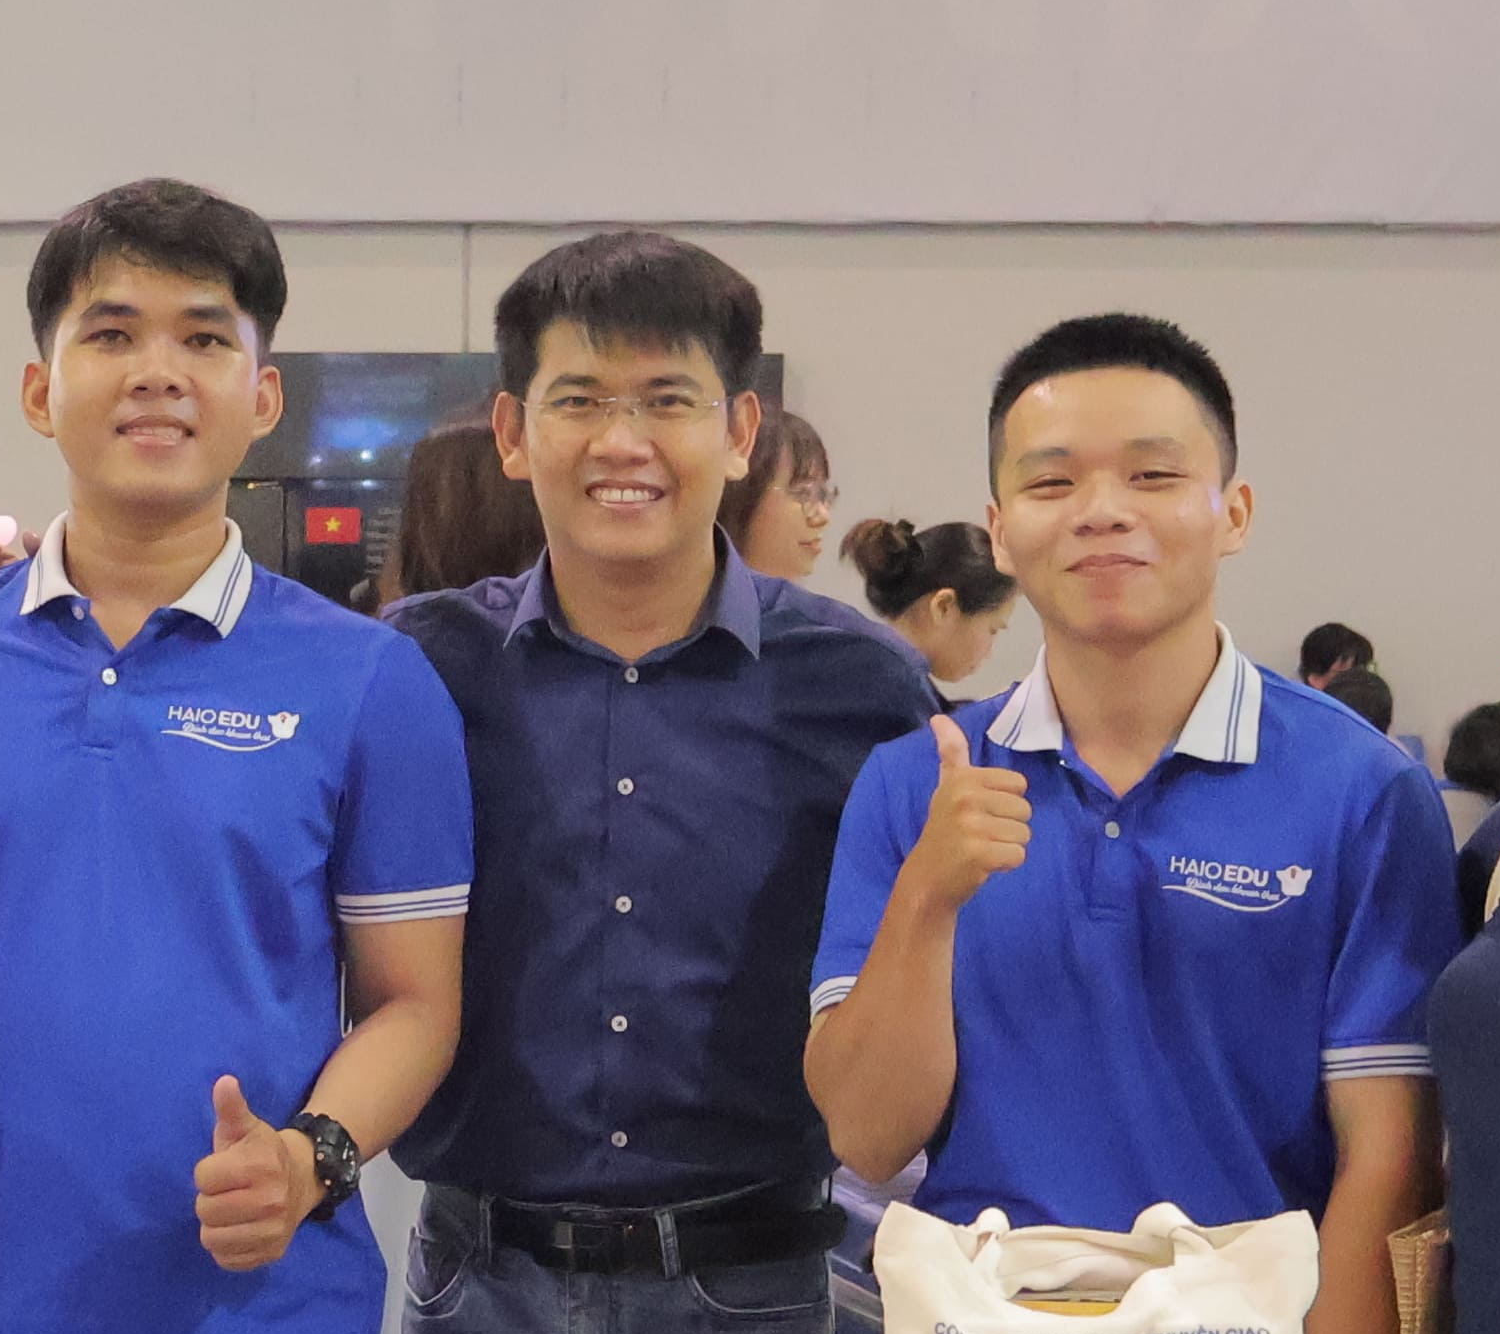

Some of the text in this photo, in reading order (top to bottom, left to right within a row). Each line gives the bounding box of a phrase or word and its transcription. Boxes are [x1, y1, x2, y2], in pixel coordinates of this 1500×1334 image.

[167, 705, 260, 729] HAIO EDU
[1169, 855, 1269, 887] HAIO EDU
